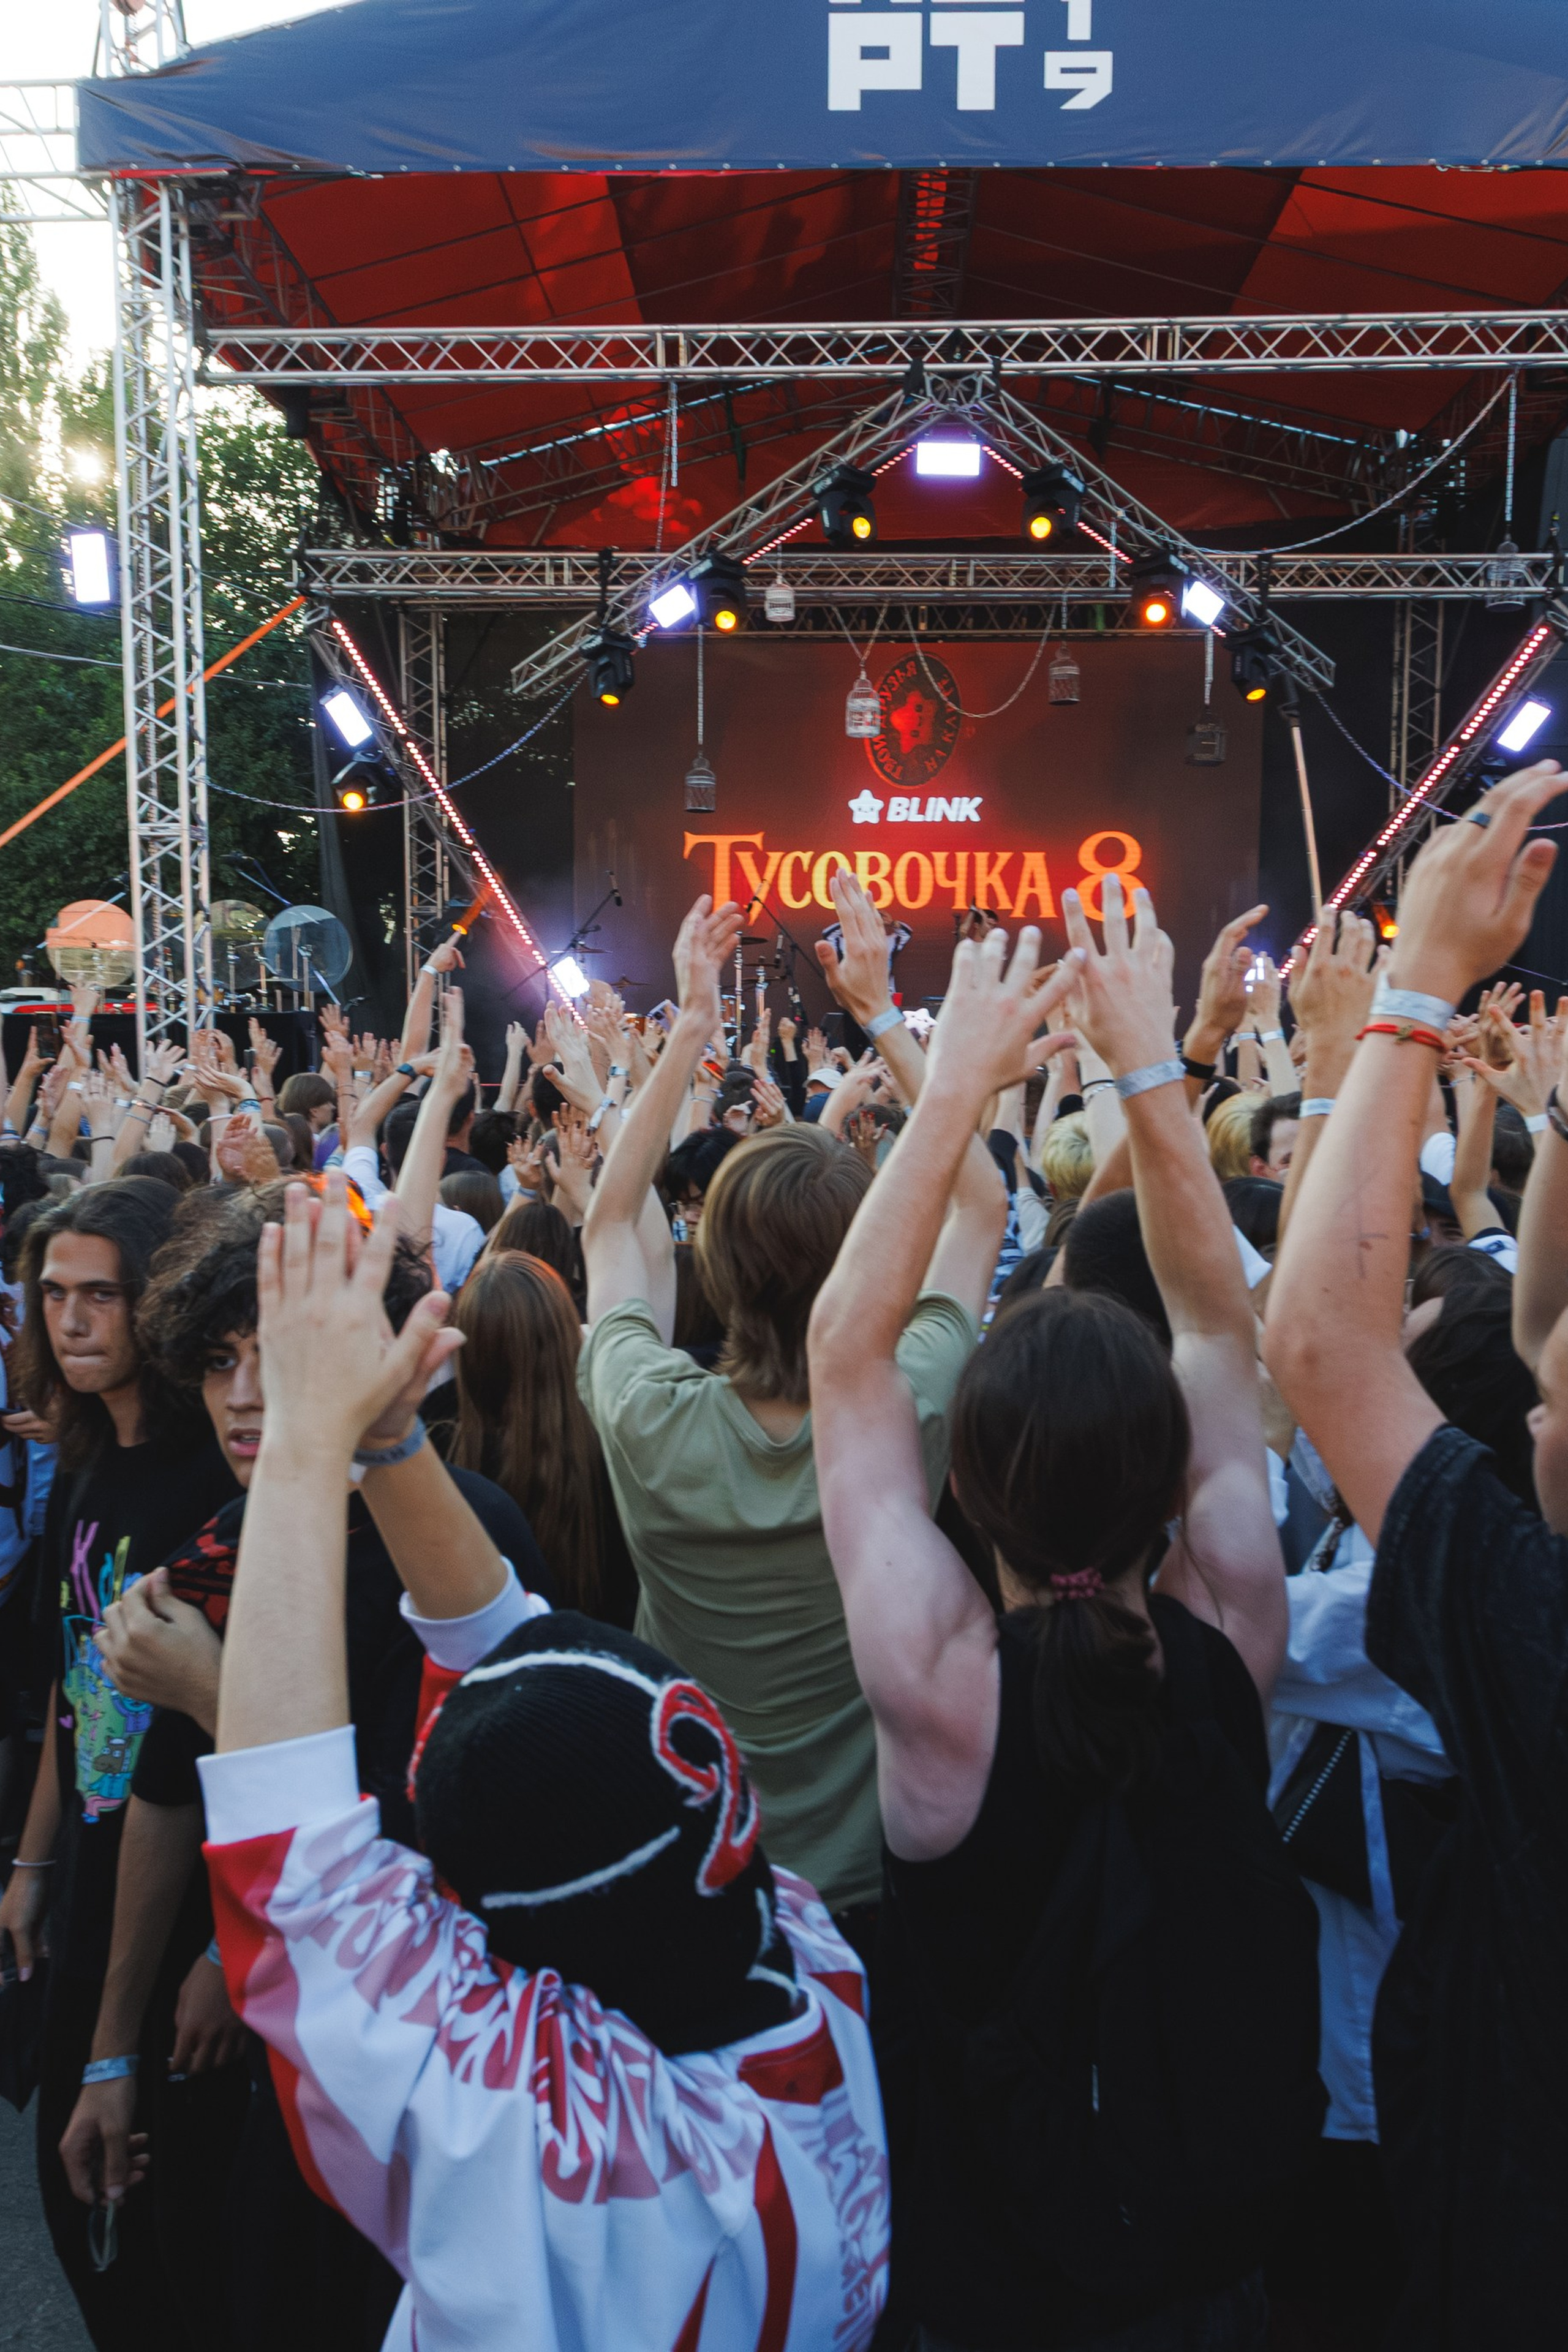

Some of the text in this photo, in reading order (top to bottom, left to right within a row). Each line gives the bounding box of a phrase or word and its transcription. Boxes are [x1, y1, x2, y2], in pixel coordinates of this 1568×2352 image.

[828, 12, 1113, 111] РТ 9
[886, 797, 983, 822] BLINK
[1075, 831, 1145, 922] 8
